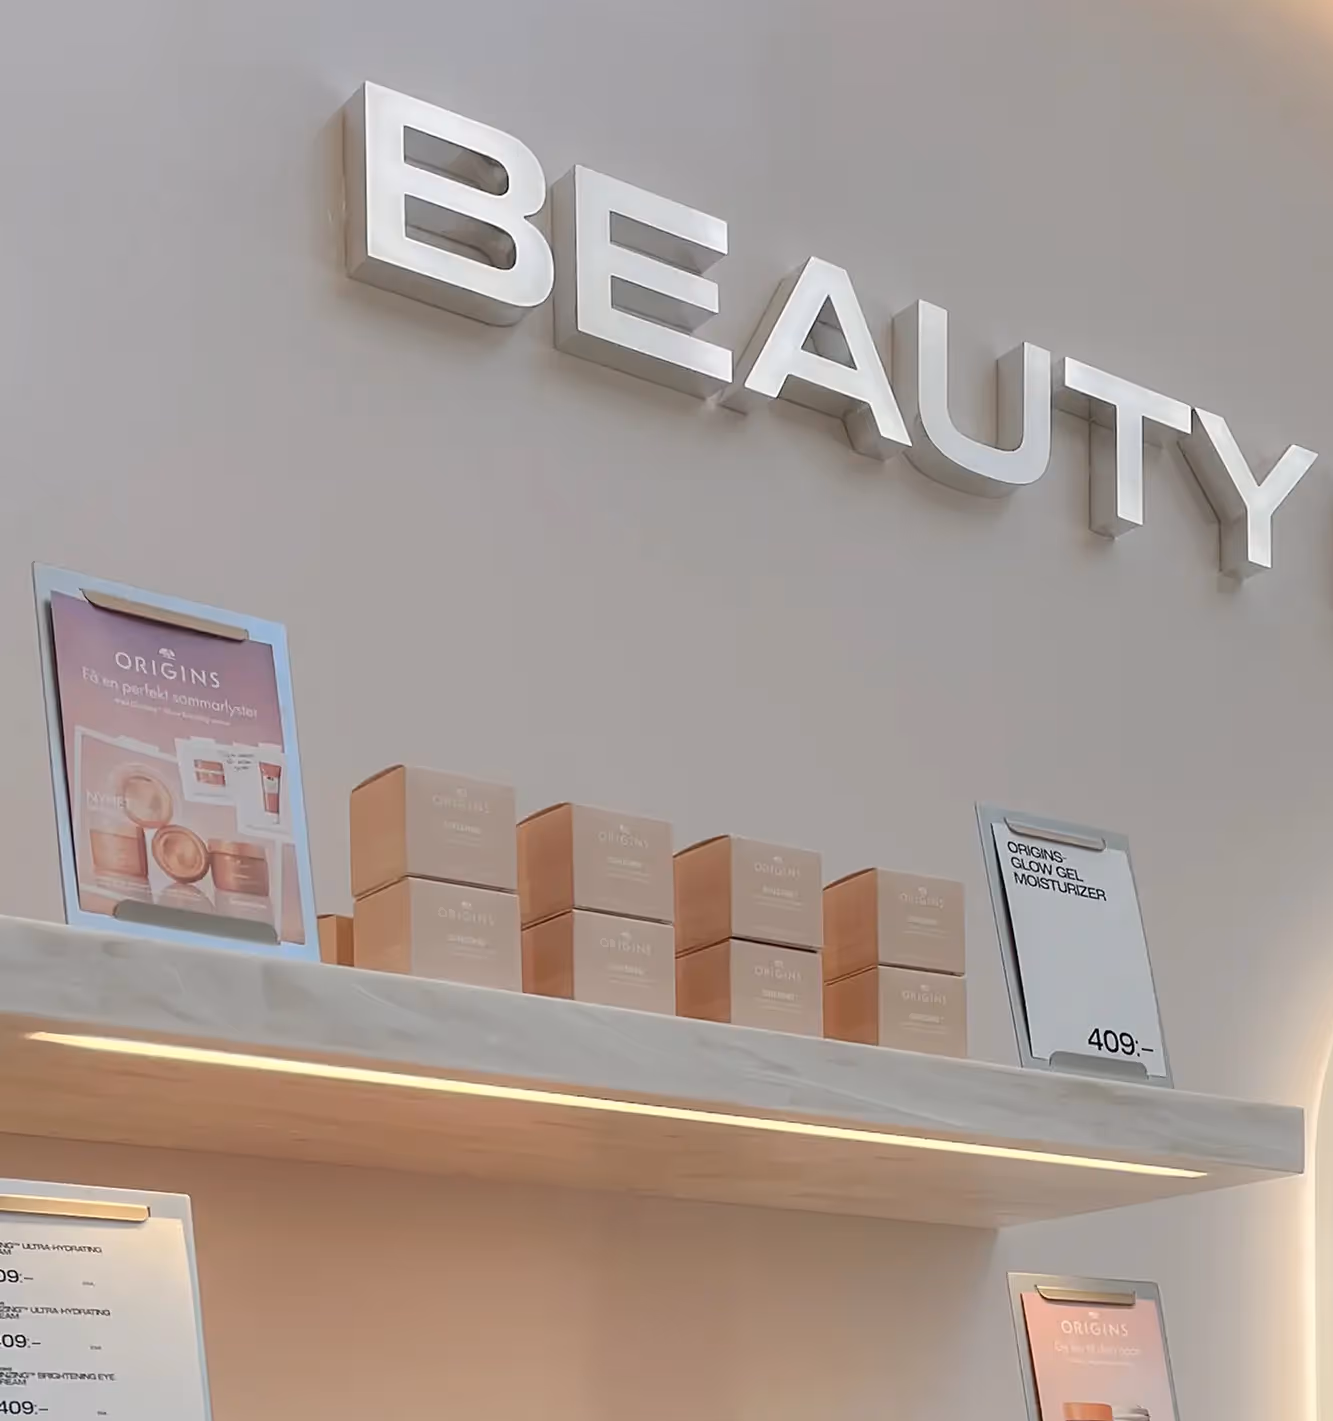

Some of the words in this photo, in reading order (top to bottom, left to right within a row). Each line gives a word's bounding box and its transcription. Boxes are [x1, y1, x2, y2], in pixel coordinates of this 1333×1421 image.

[350, 80, 1319, 575] BEAUTY
[115, 651, 220, 689] ORIGINS
[1011, 857, 1053, 876] GLOW
[1056, 866, 1084, 883] GEL
[1014, 872, 1107, 902] MOISTURIZER
[1060, 1319, 1129, 1338] ORIGINS
